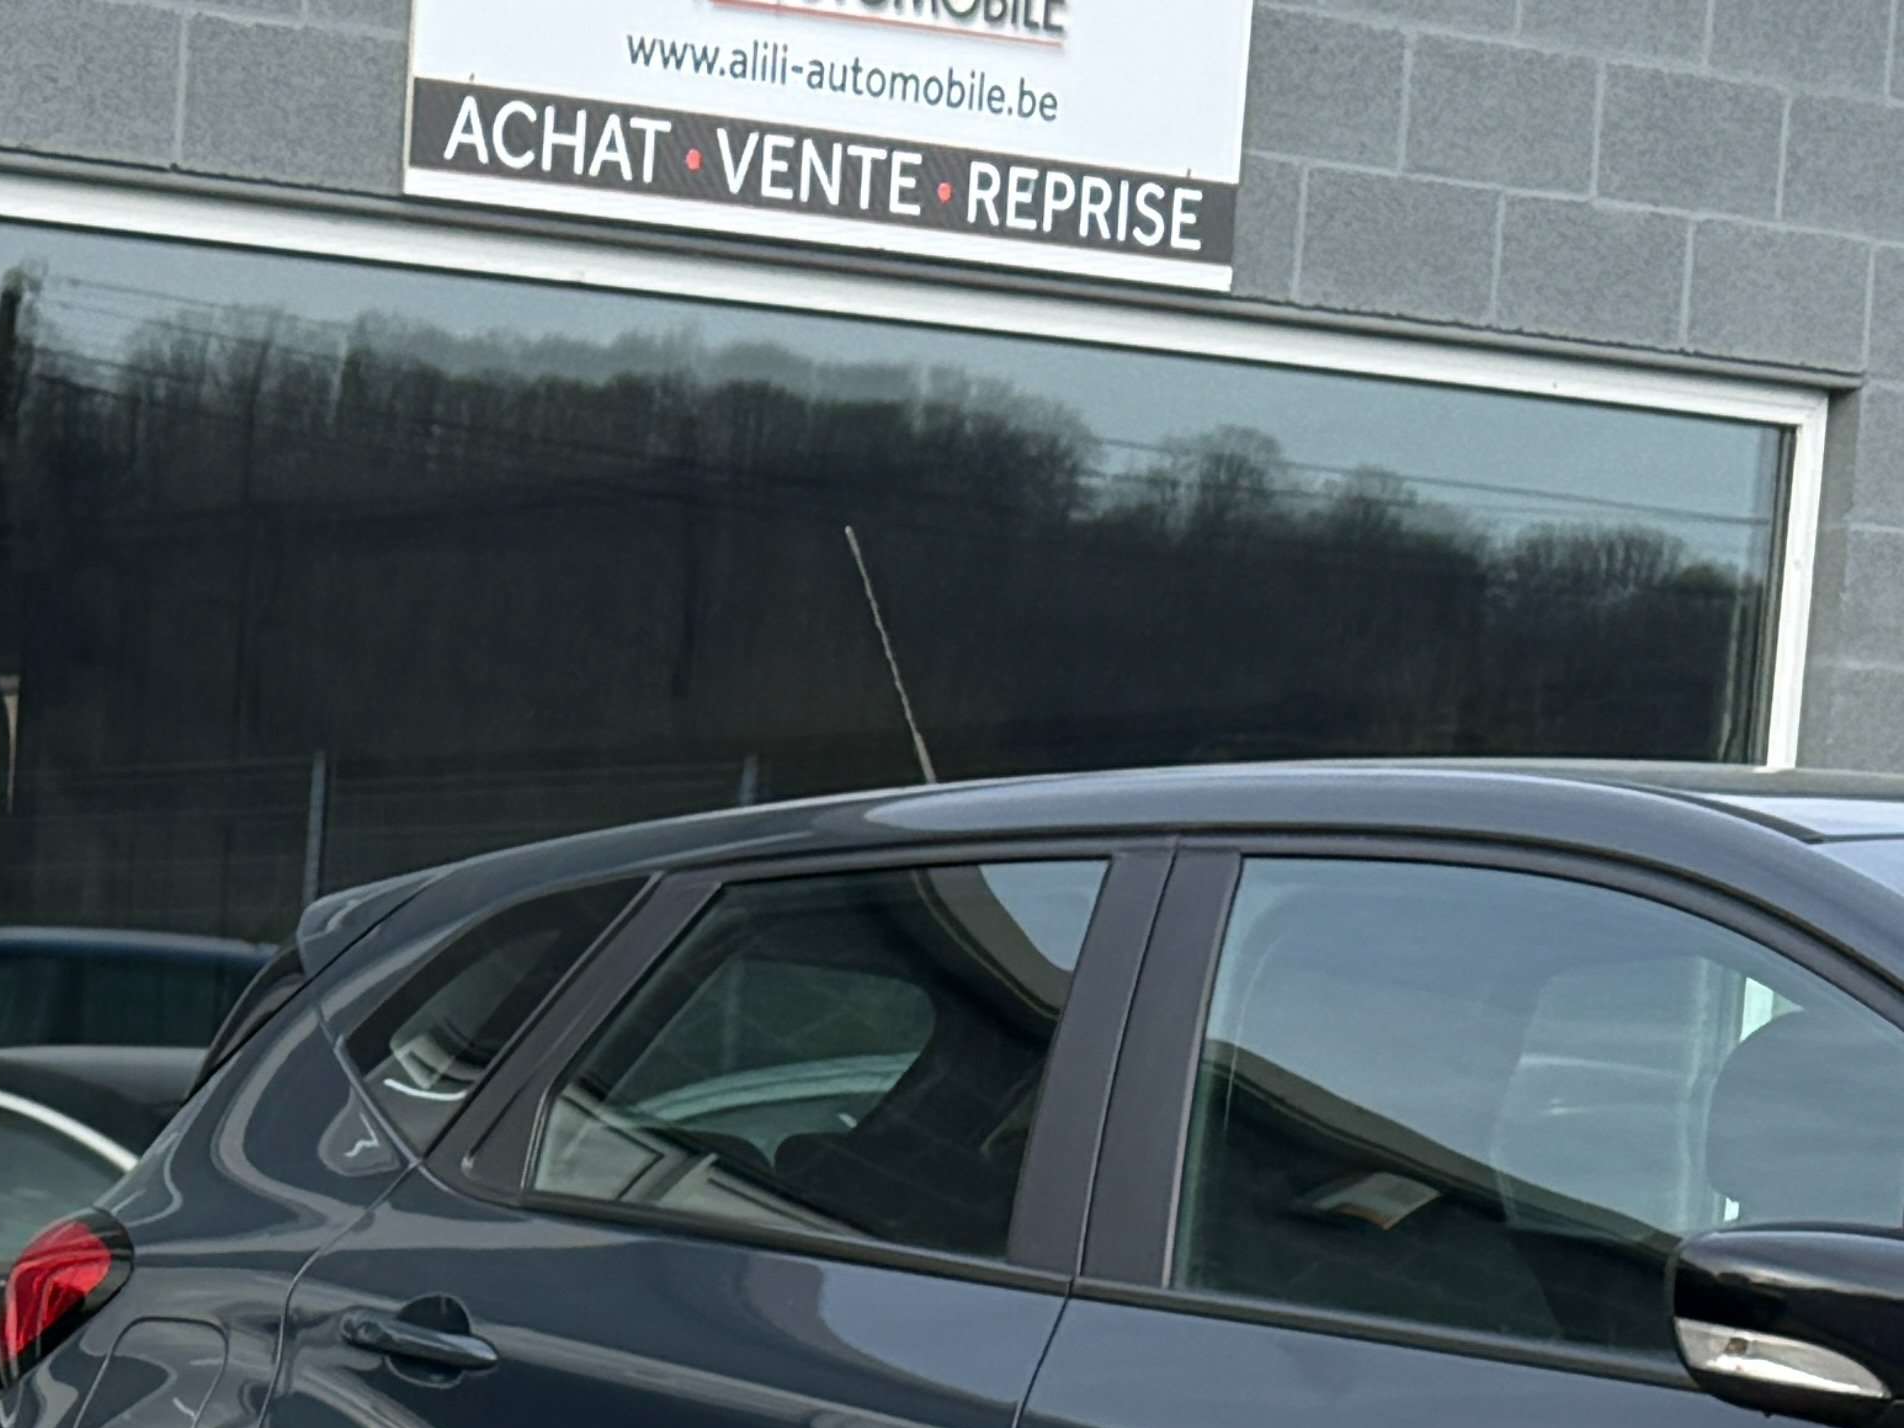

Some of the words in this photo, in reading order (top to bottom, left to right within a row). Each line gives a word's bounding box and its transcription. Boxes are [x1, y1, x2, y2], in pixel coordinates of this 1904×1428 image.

[626, 33, 1058, 121] www.alili-automobile.be
[443, 95, 672, 184] ACHAT
[716, 127, 923, 217] VENTE
[966, 160, 1204, 251] REPRISE
